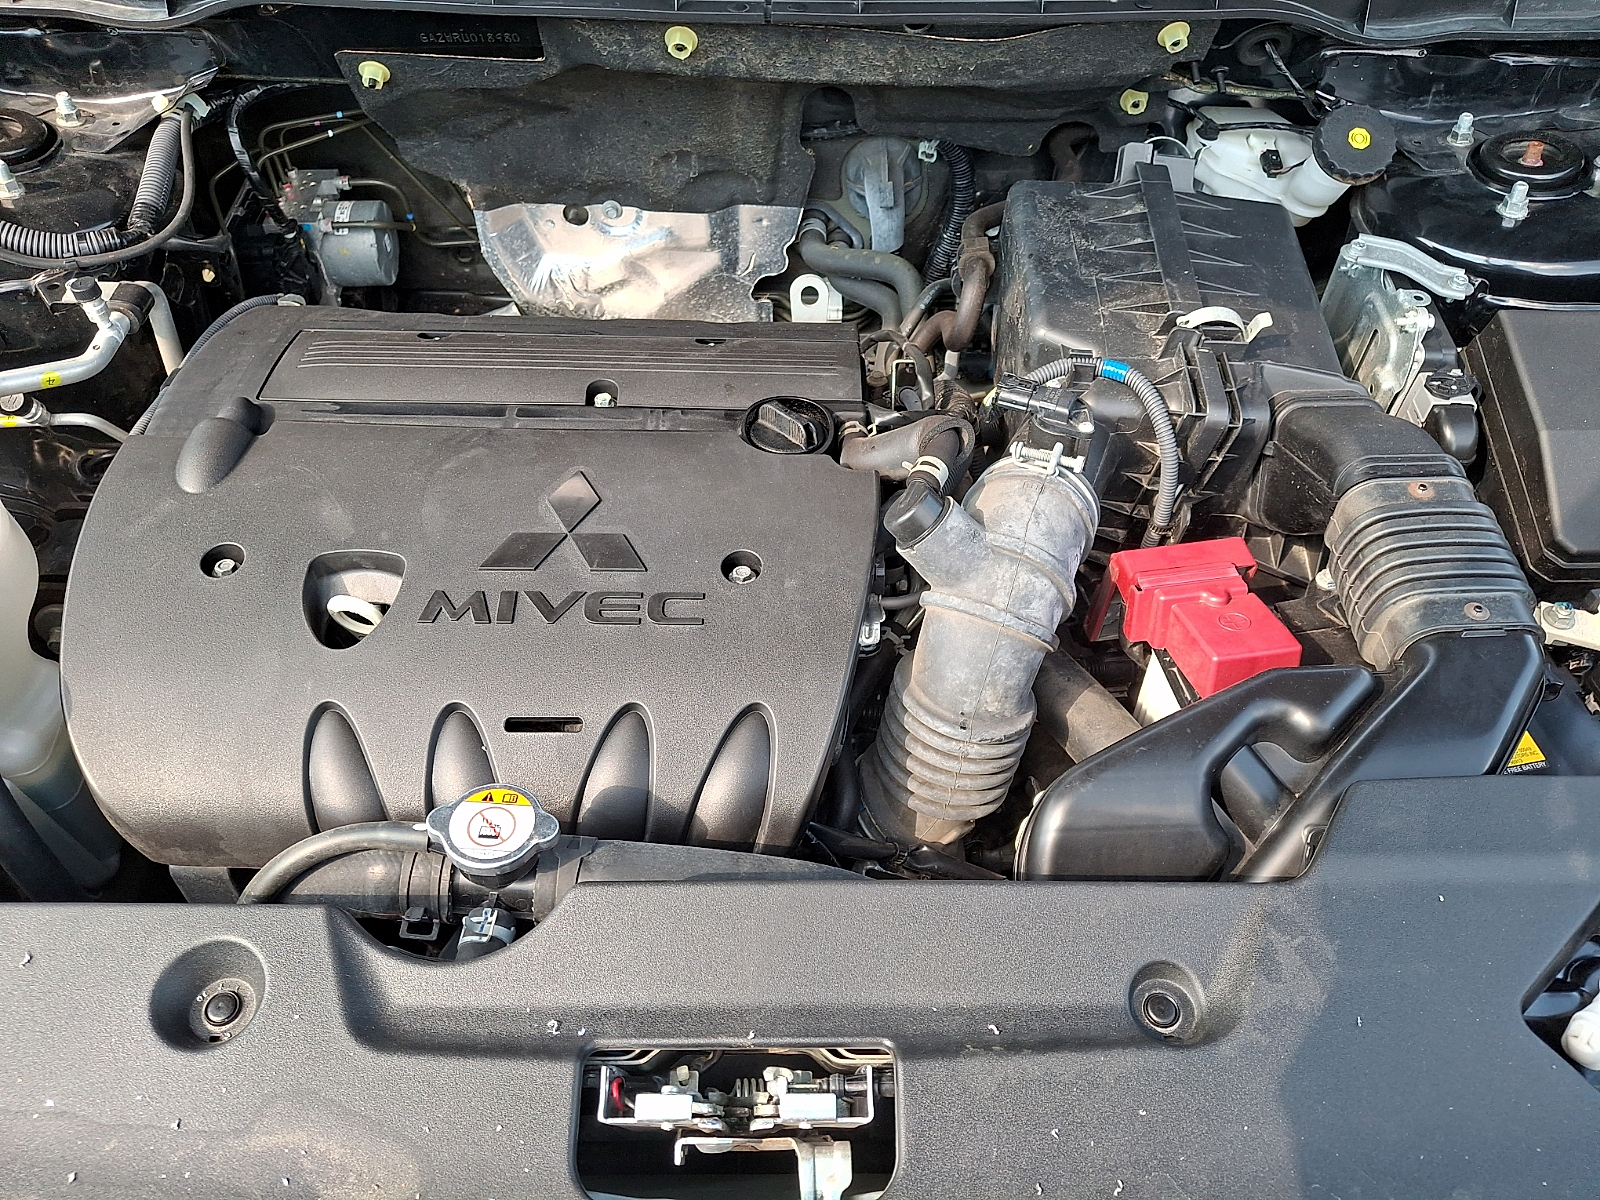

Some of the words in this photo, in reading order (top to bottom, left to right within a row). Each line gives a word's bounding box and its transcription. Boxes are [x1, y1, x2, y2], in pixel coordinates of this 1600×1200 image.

[417, 590, 706, 625] MIVEC
[1507, 766, 1522, 774] FREE
[1522, 761, 1547, 771] BATTERY
